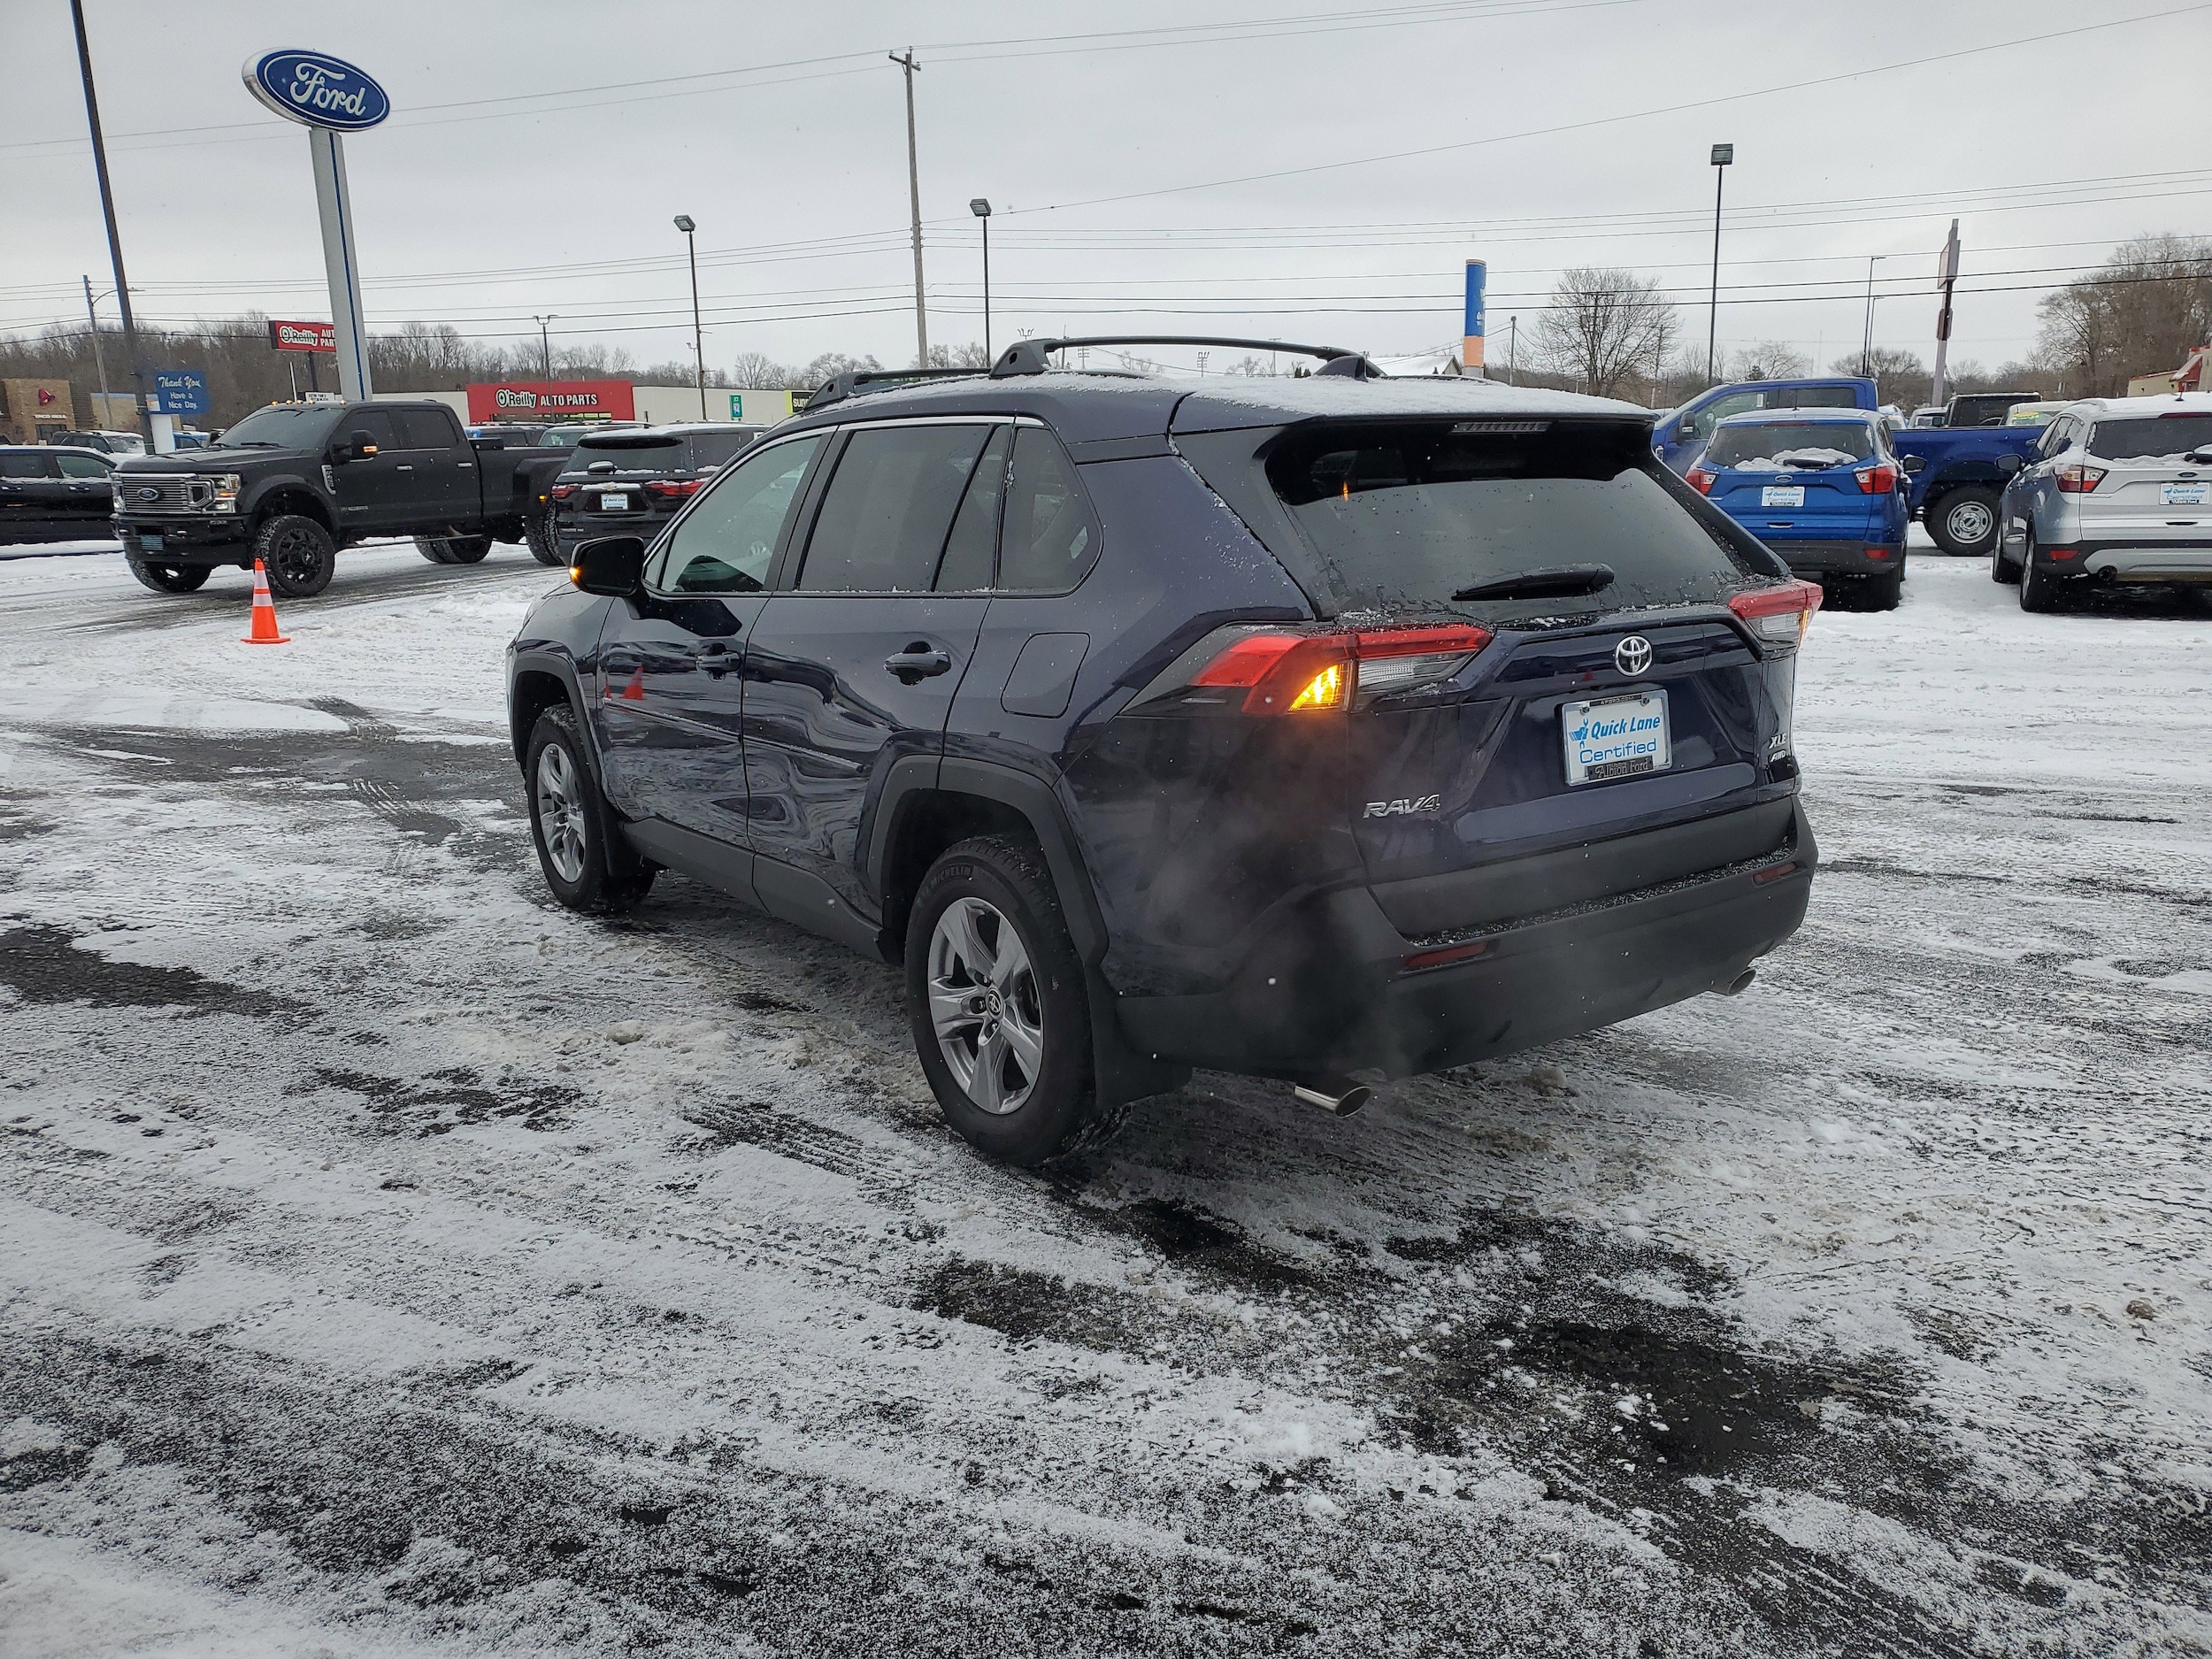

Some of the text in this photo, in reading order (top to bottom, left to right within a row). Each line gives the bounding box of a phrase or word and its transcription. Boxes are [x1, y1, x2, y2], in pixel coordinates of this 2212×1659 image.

[289, 62, 366, 116] Ford
[280, 325, 319, 347] O'Reilly
[320, 338, 336, 347] PAR
[321, 329, 335, 338] AUT
[157, 375, 202, 389] Thank You
[495, 388, 537, 408] O'Reilly
[566, 394, 598, 406] PARTS
[1591, 716, 1661, 740] Quick Lane
[1579, 738, 1656, 764] Certified
[1769, 733, 1786, 749] XLE
[1594, 764, 1628, 779] Albion
[1629, 757, 1648, 773] Ford
[1363, 795, 1440, 818] RAV4
[930, 865, 972, 890] MICHELIN
